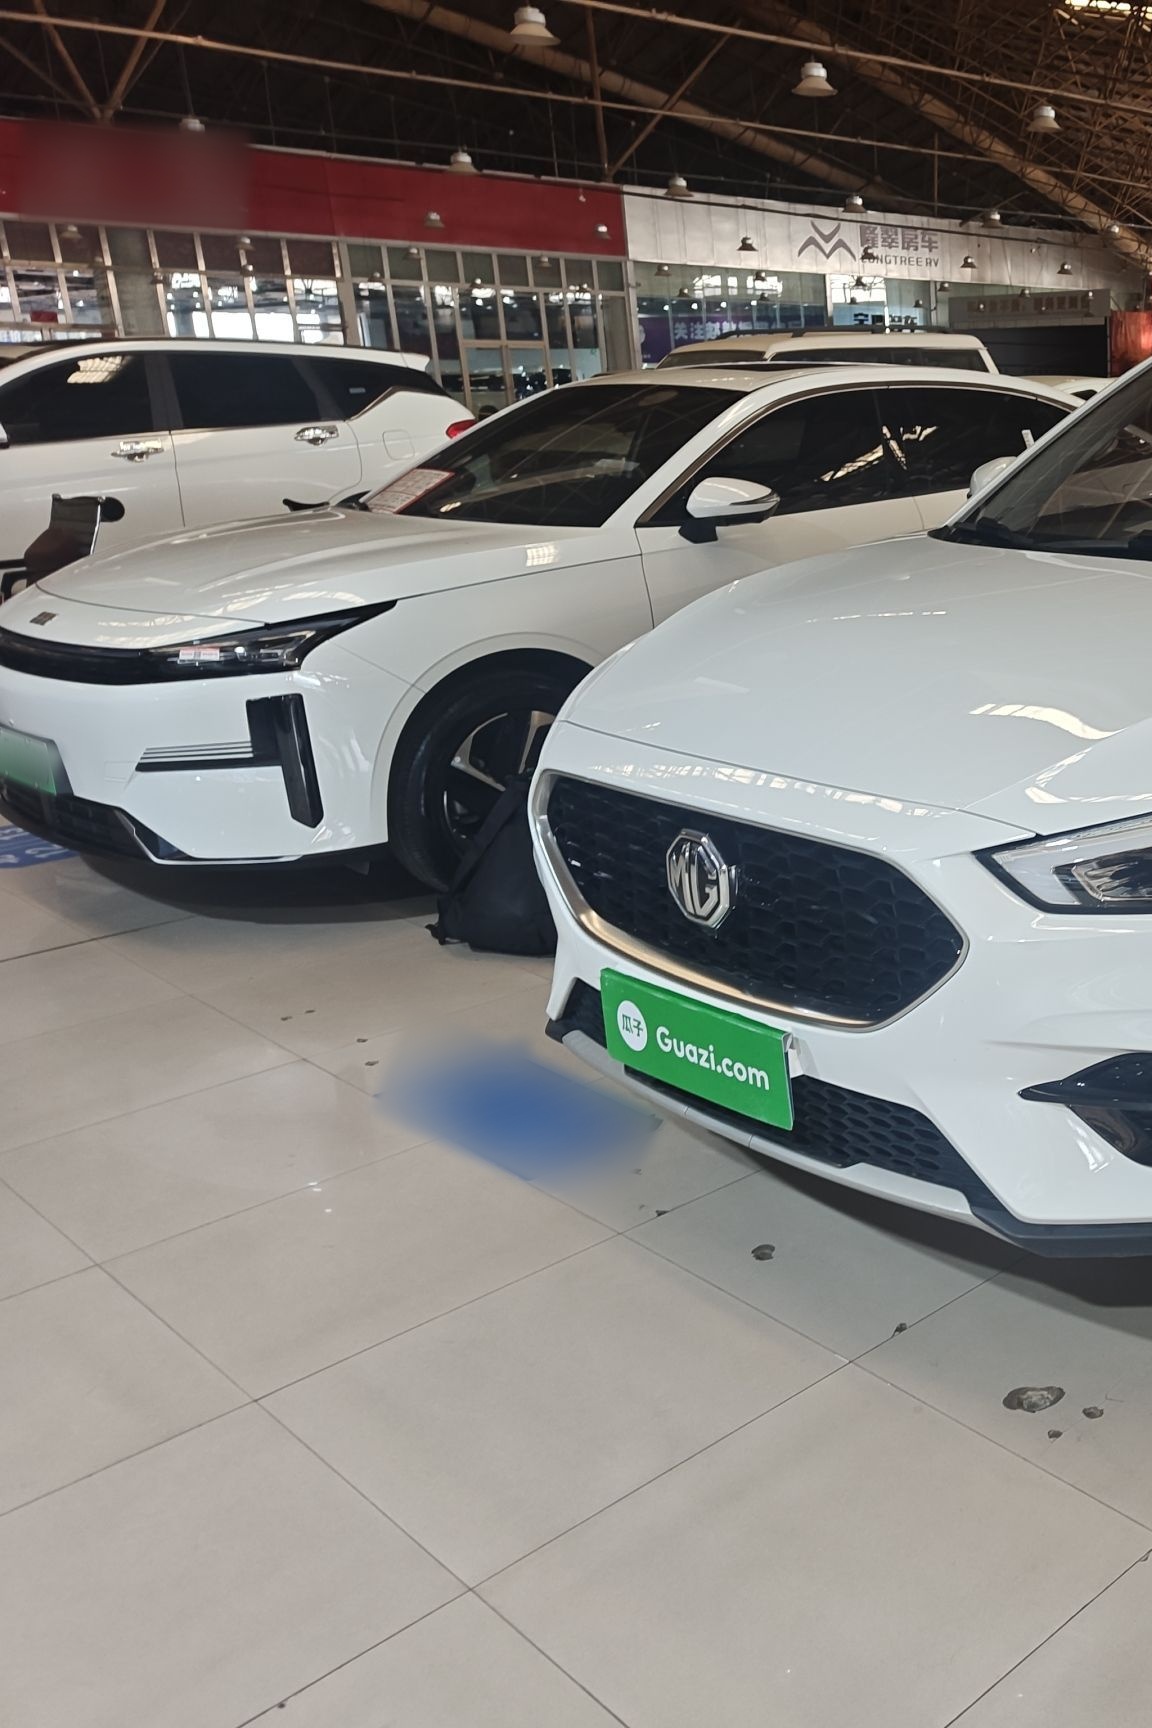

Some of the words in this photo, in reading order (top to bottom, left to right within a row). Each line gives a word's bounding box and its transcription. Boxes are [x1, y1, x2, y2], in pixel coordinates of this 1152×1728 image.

[925, 257, 940, 268] RV
[668, 838, 720, 918] MG
[622, 1013, 644, 1037] 瓜子
[656, 1026, 770, 1090] Guazi.com
